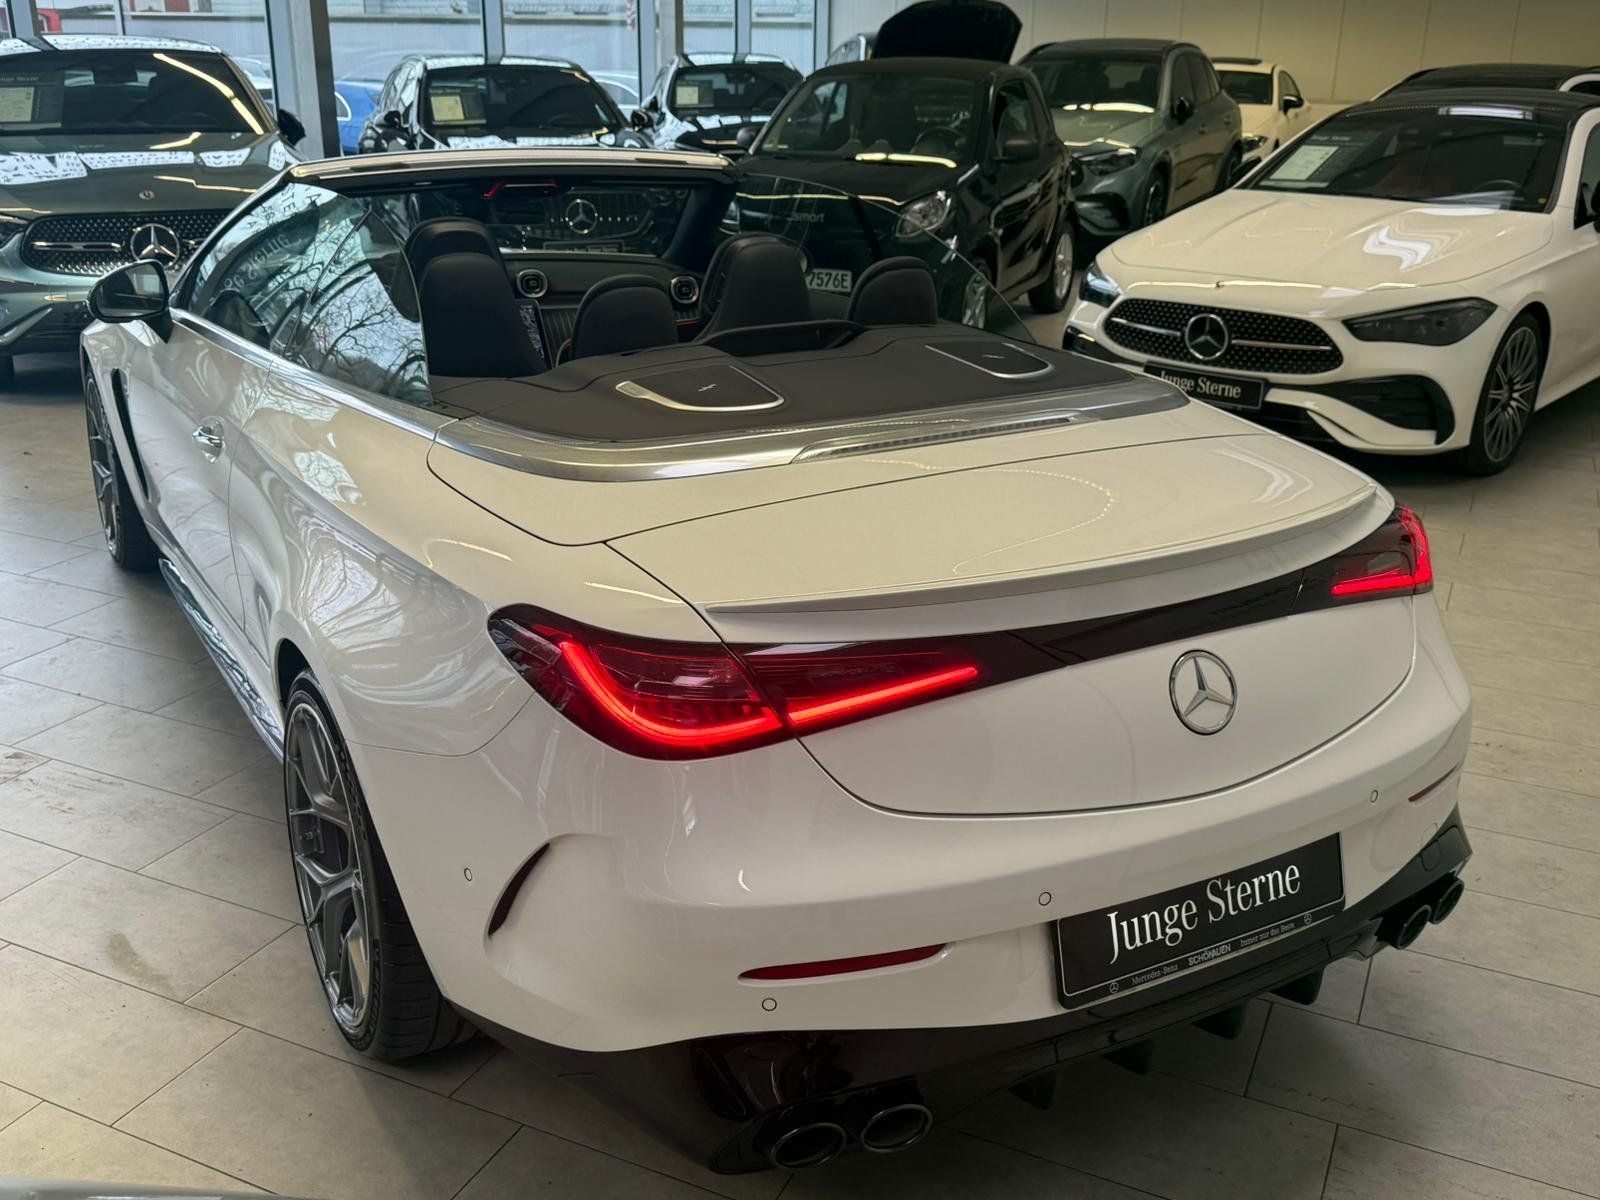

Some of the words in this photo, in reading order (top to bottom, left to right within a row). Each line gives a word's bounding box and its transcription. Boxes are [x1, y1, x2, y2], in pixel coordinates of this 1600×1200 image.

[809, 272, 849, 289] 7576E
[1197, 376, 1241, 398] Sterne
[1107, 899, 1198, 964] Junge
[1206, 864, 1300, 923] Sterne
